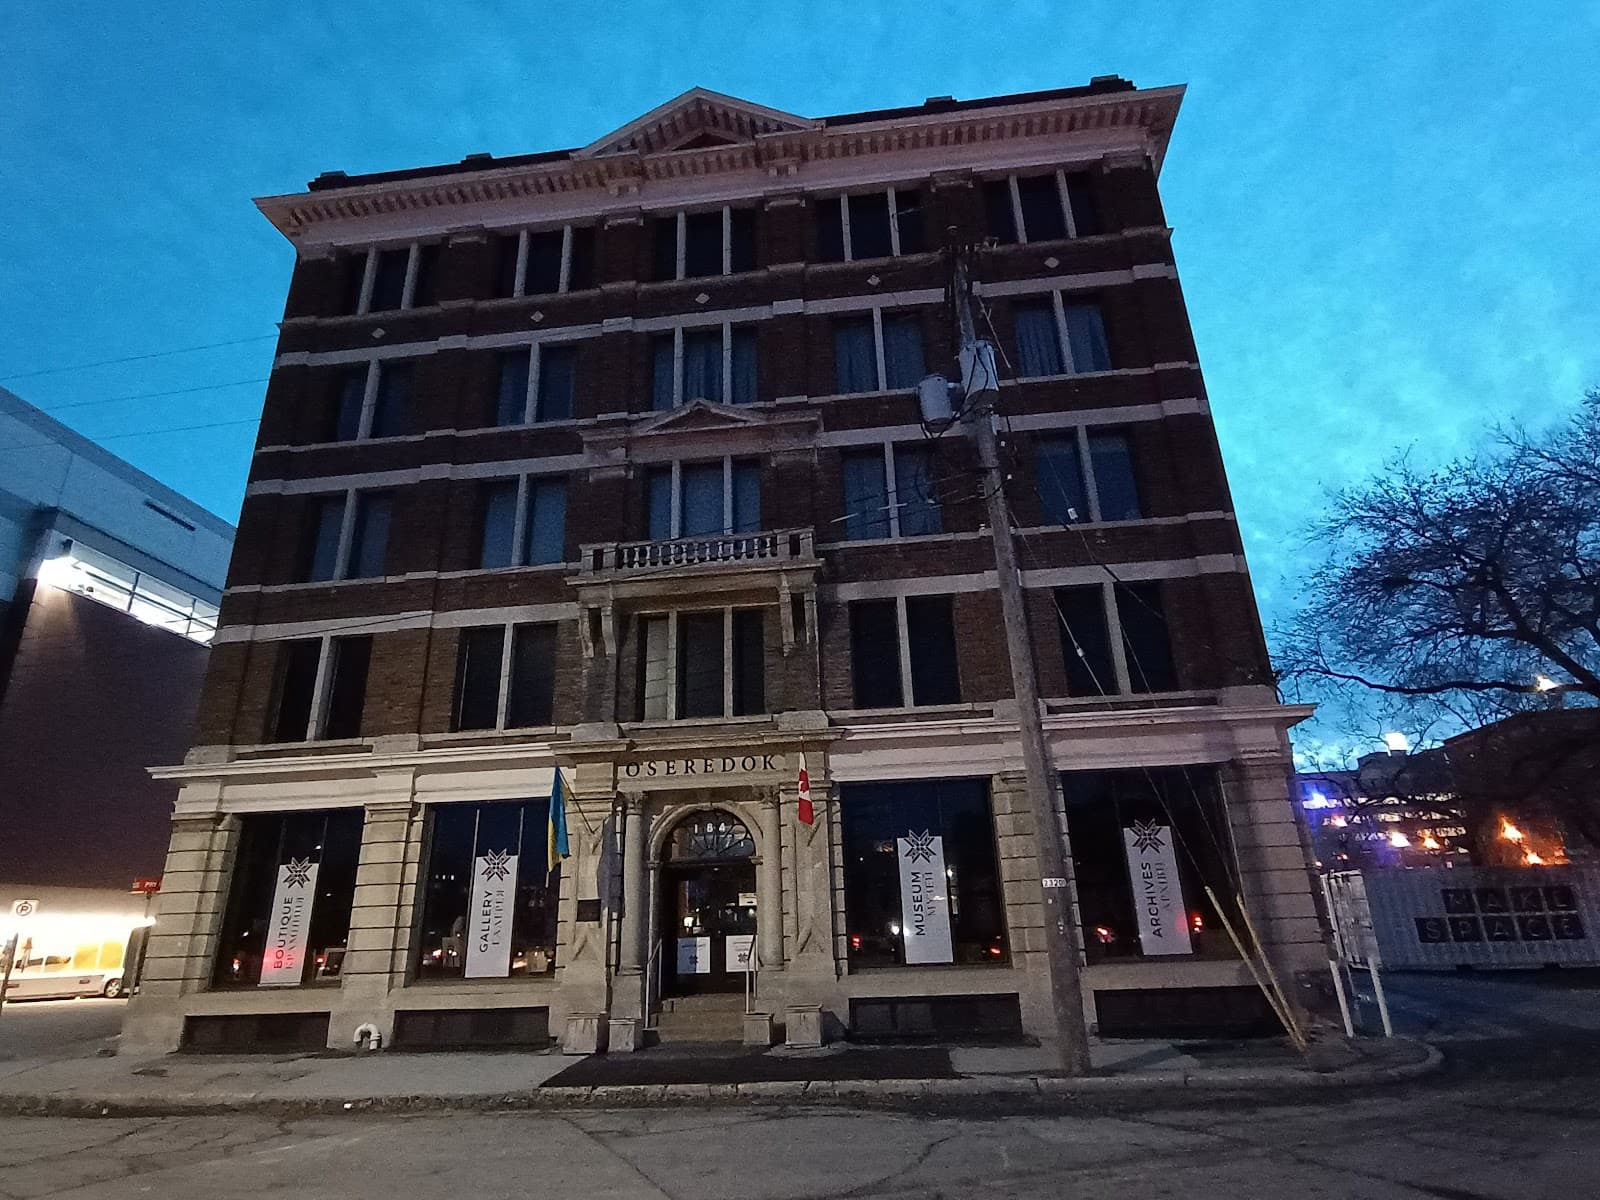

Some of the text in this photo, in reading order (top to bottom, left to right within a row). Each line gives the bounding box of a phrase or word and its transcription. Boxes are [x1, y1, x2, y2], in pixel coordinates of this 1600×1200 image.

[625, 755, 777, 777] OSEREDOK
[694, 822, 726, 834] 184
[479, 890, 493, 953] GALLERY
[911, 871, 925, 936] MUSEUM
[1141, 862, 1163, 938] ARCHIVES
[1446, 889, 1571, 911] MAKE
[273, 896, 294, 969] BOUTIQUE
[1422, 917, 1577, 940] SPACE
